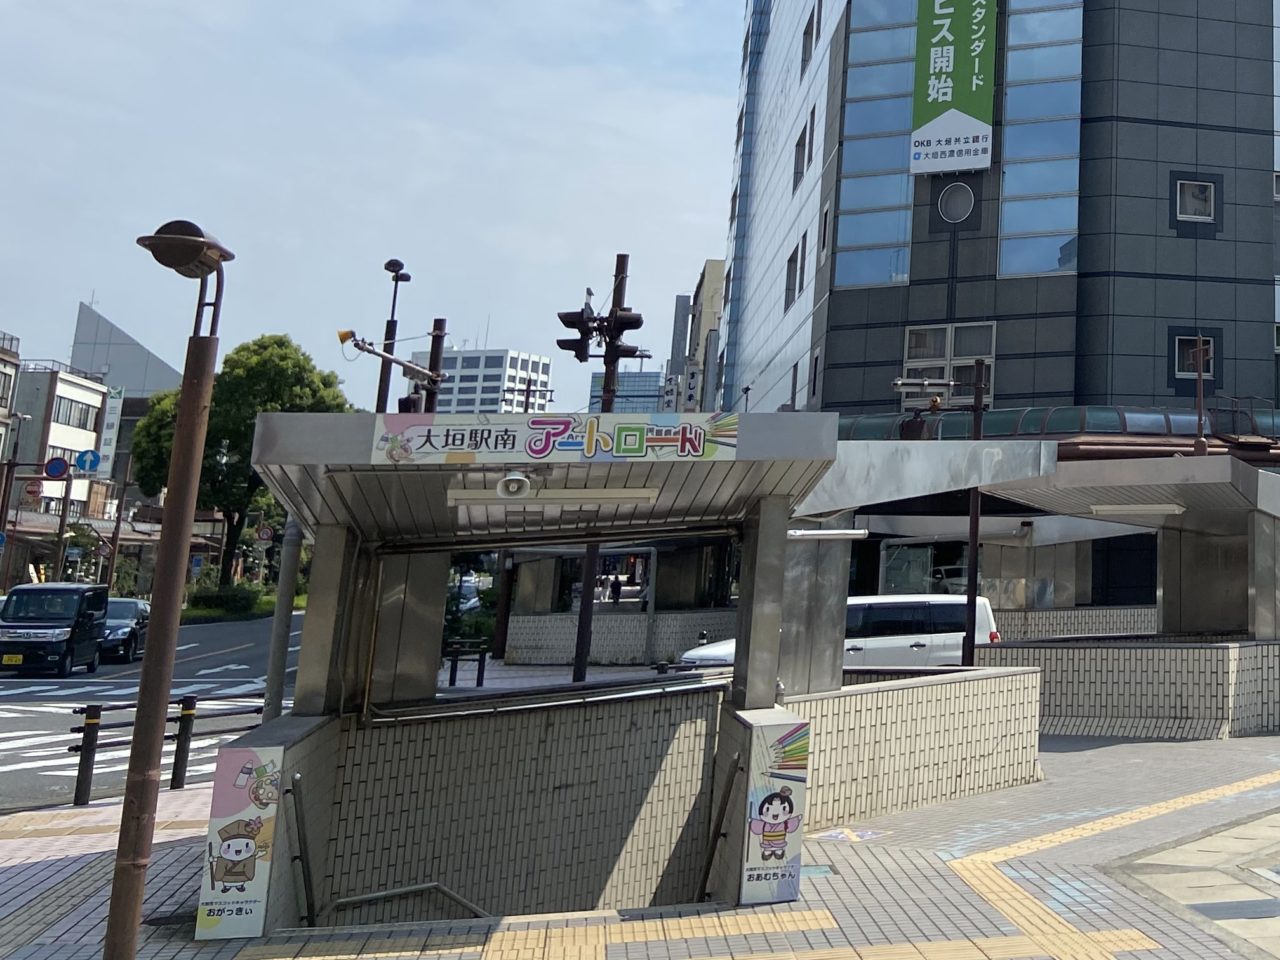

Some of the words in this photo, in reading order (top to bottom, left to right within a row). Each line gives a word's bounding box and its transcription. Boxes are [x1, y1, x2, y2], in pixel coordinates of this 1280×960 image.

[913, 139, 932, 148] OKB
[935, 134, 989, 147] 大垣共立銀行
[415, 427, 517, 452] 大垣駅南
[525, 416, 706, 458] アートロード
[747, 872, 796, 882] おあむちゃん
